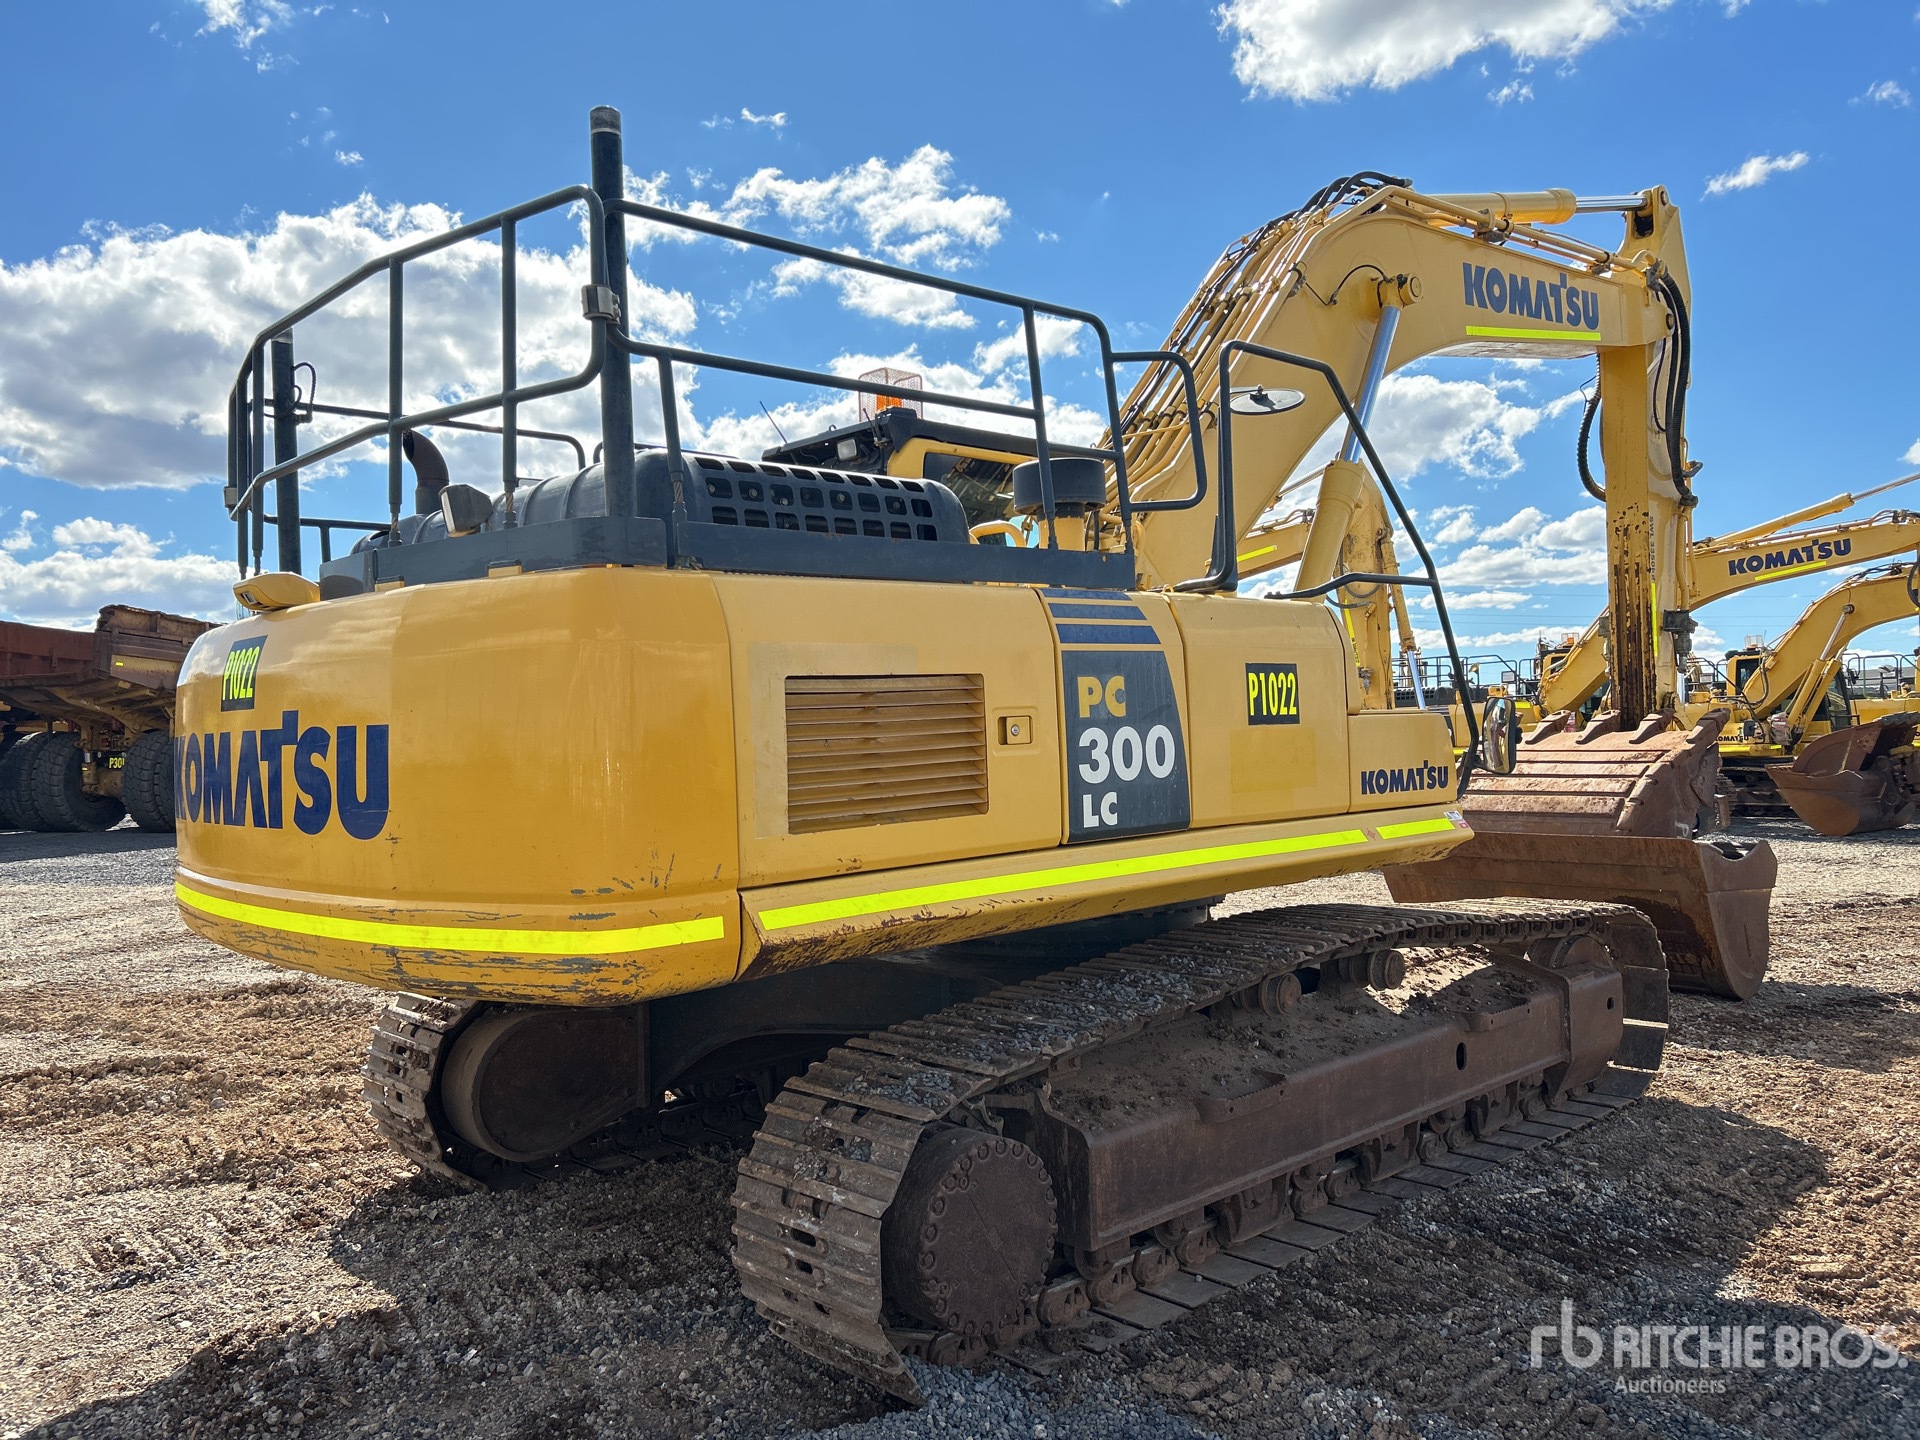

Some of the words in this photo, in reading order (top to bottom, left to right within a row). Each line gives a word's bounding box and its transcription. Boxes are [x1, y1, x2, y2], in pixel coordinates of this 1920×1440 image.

[1463, 262, 1600, 330] KOMATSU
[1728, 538, 1852, 576] KOMATSU
[222, 646, 260, 700] P1022
[1248, 672, 1297, 716] P1022
[1077, 675, 1127, 718] PC
[174, 710, 389, 840] KOMATSU
[1079, 724, 1175, 784] 300
[1361, 760, 1449, 795] KOMATSU
[1082, 791, 1118, 828] LC
